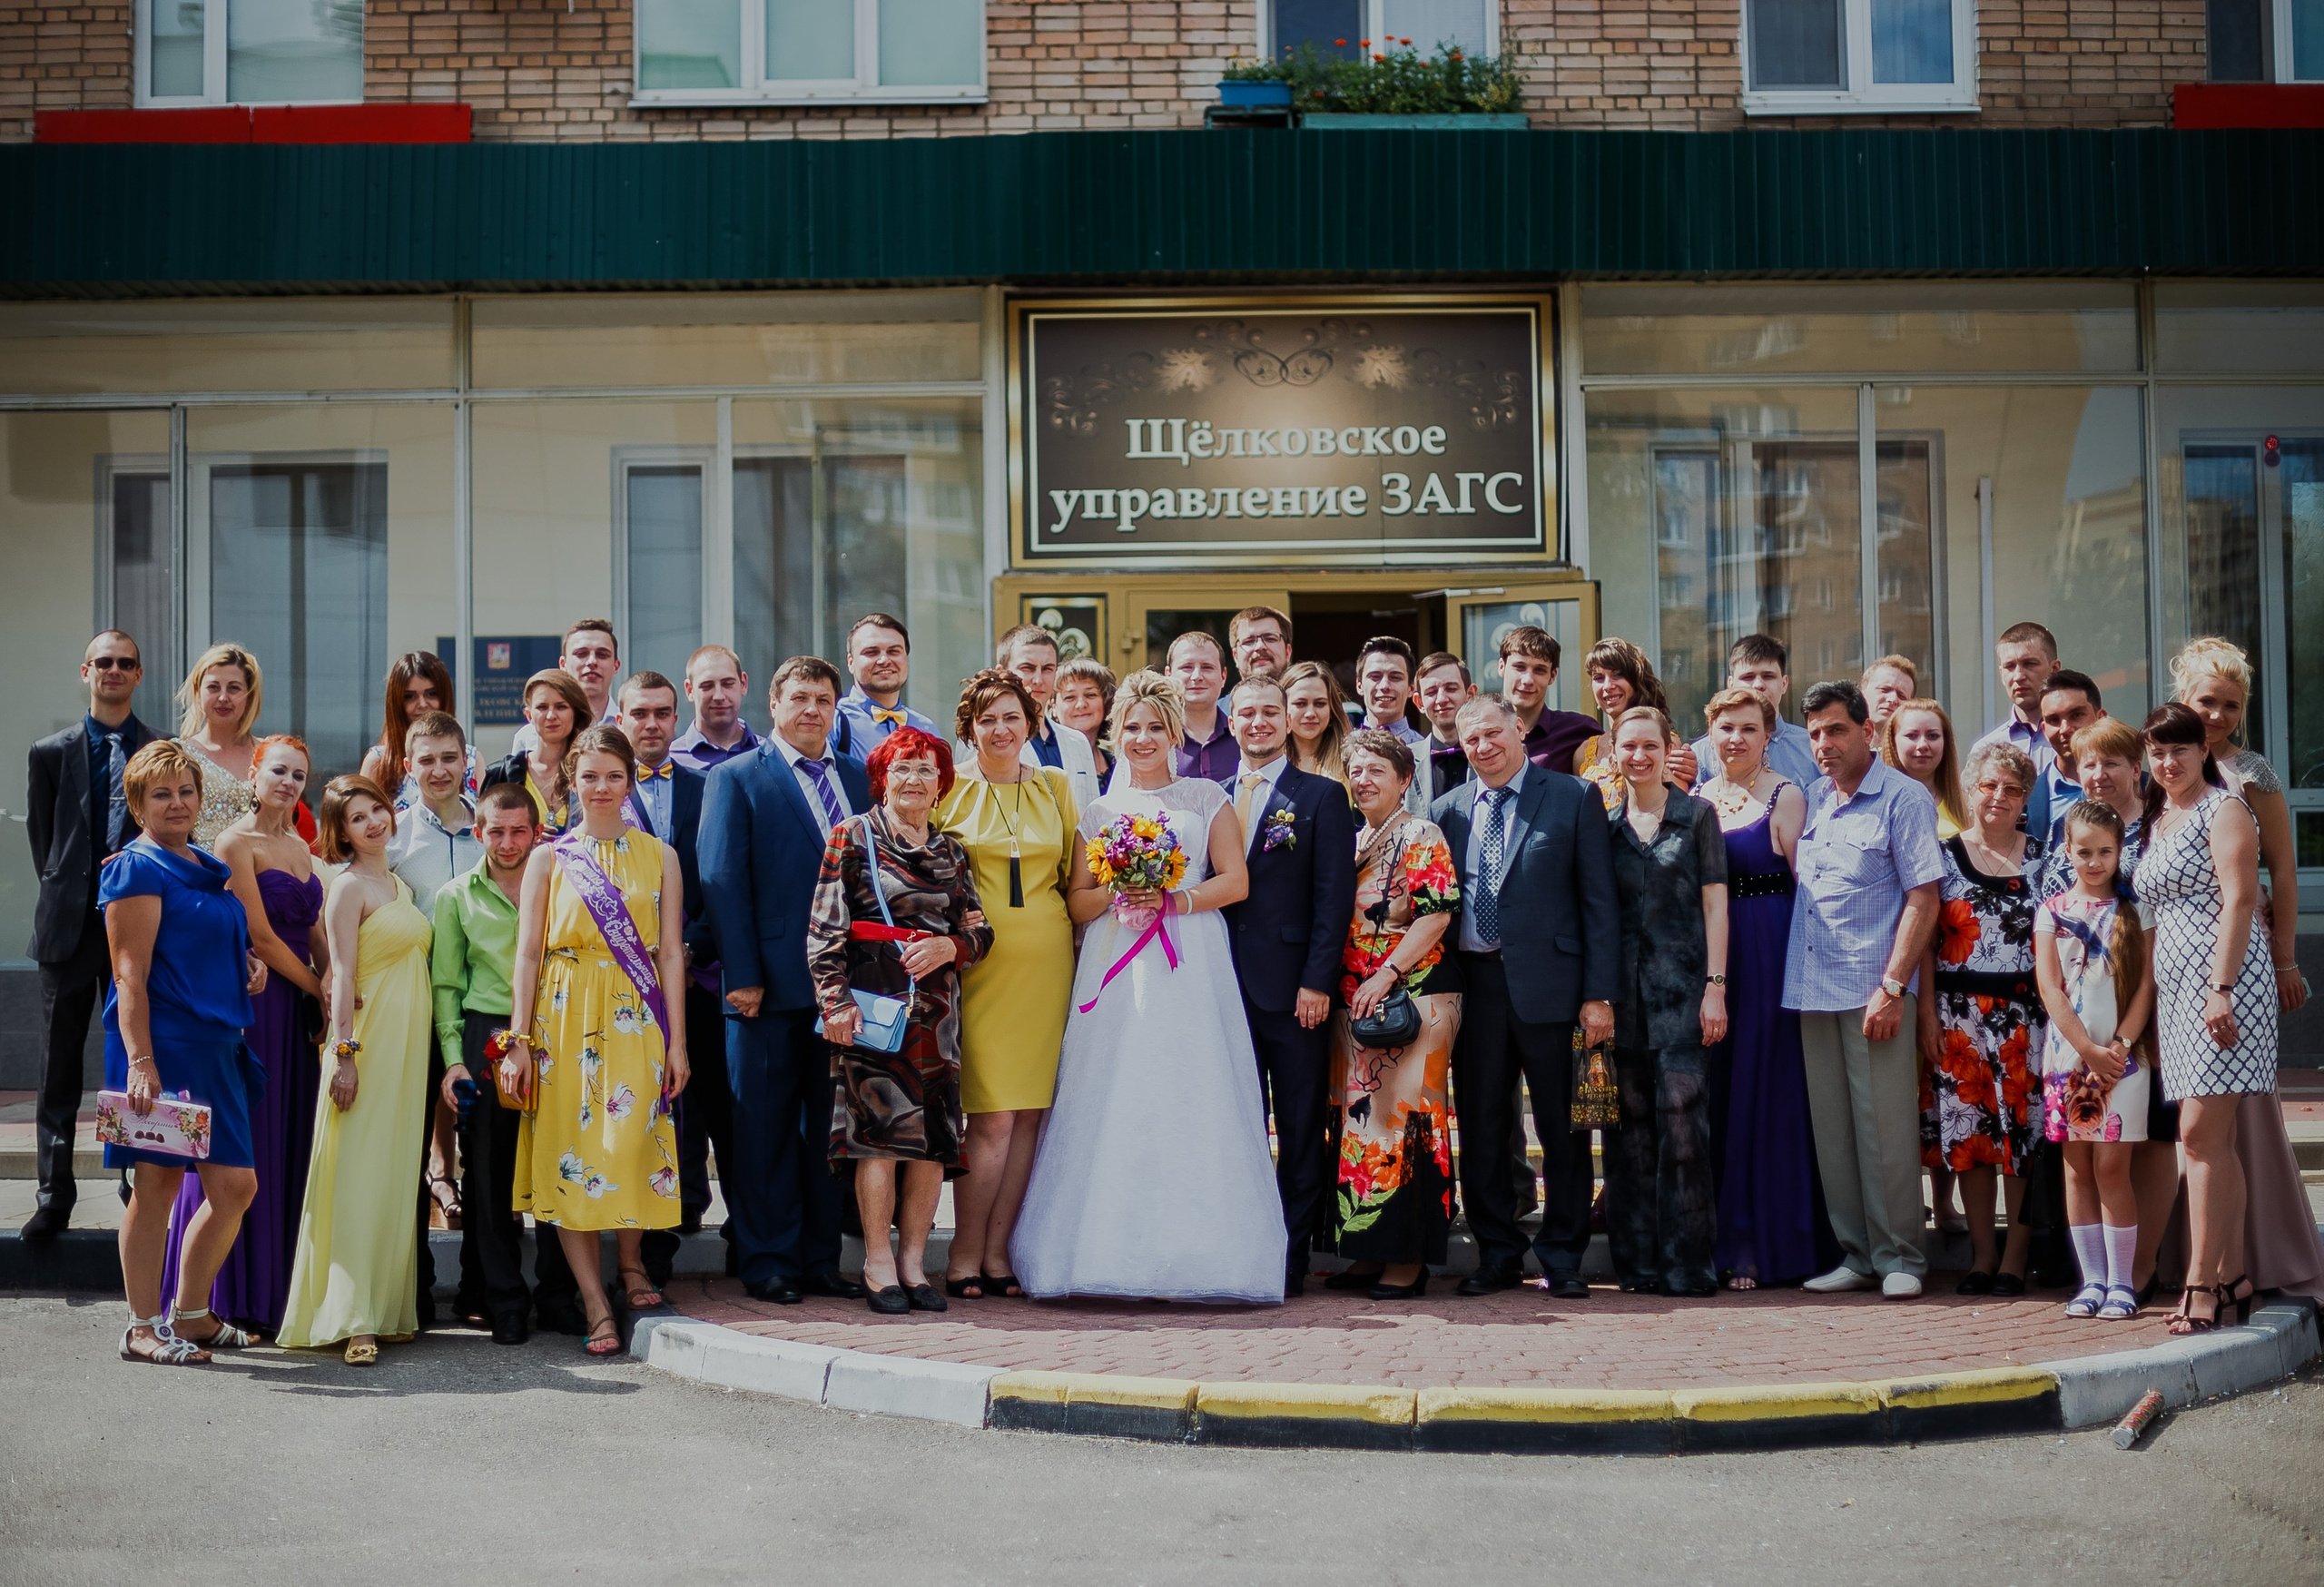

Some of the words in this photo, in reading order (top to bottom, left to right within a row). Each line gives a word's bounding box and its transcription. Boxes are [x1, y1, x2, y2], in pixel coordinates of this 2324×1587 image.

[1125, 418, 1447, 466] Щёлковское
[1048, 485, 1367, 533] управление
[1380, 472, 1524, 516] ЗАГС
